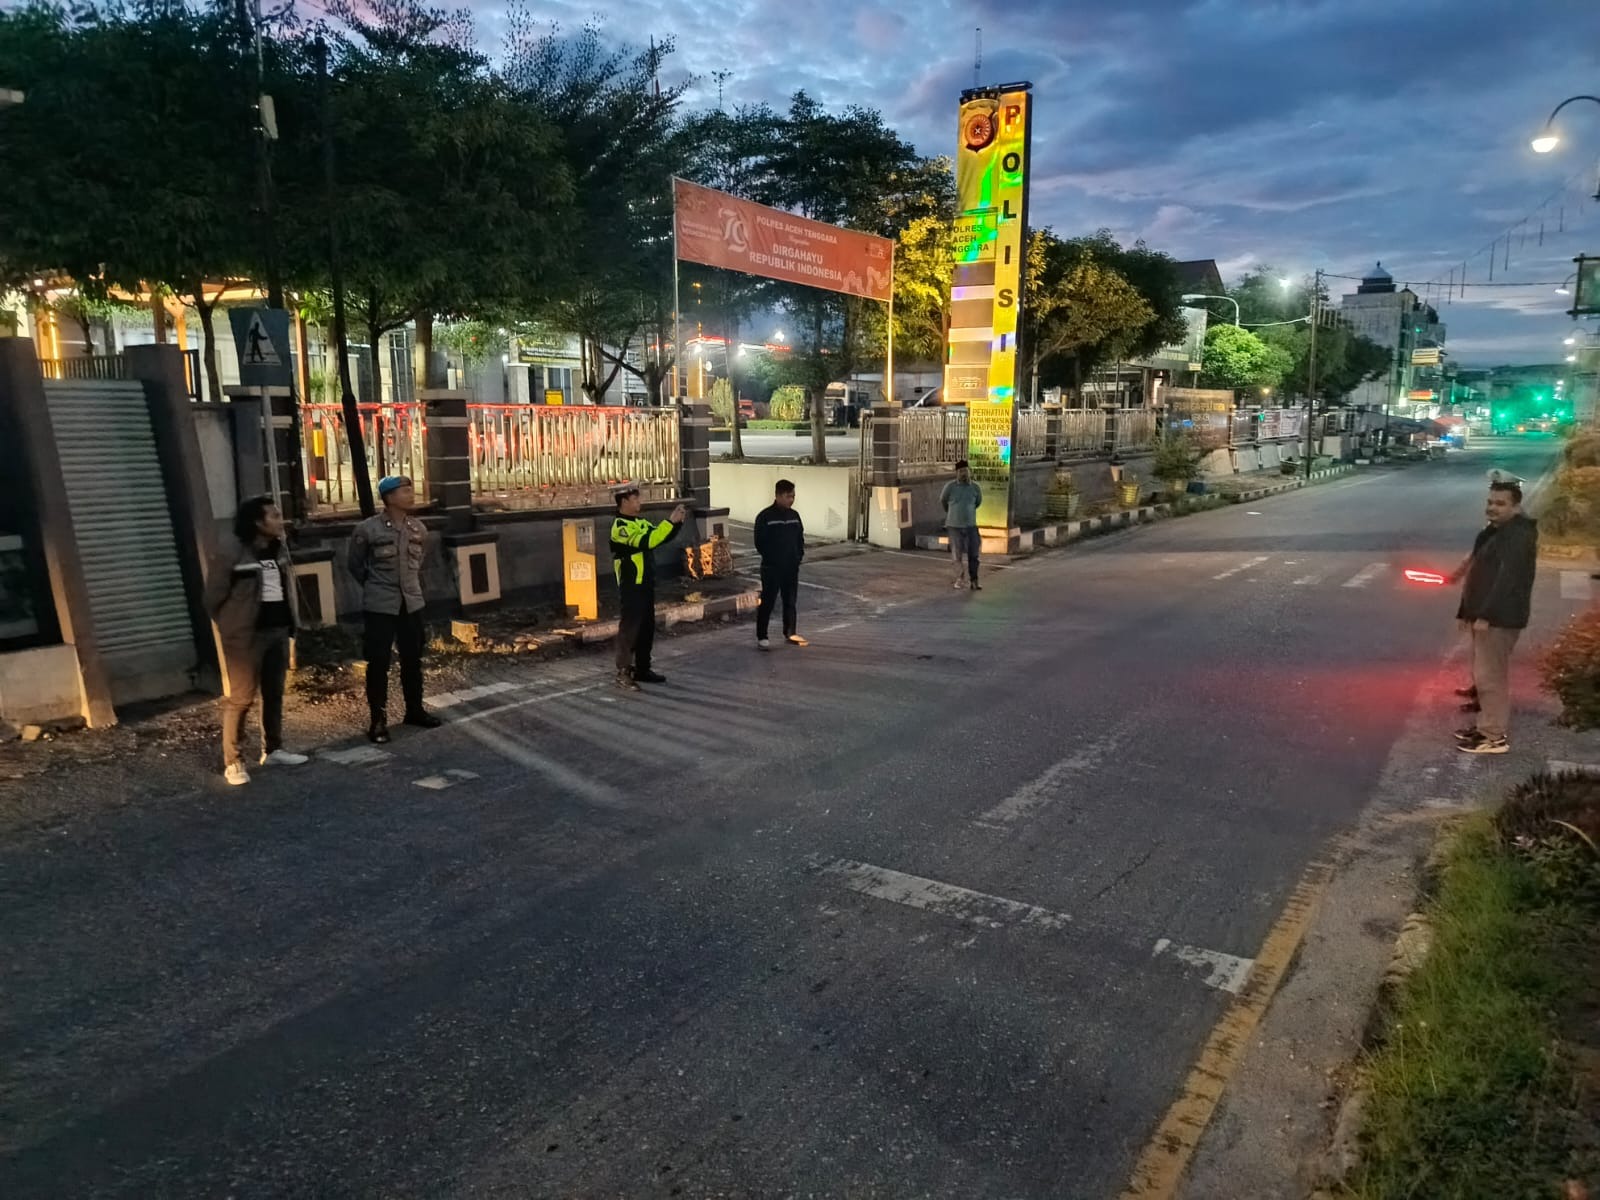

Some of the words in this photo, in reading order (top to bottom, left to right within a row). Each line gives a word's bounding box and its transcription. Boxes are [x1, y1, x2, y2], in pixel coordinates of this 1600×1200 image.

[756, 215, 784, 230] POLRES
[784, 223, 803, 235] ACEH
[803, 228, 838, 244] TENGGARA
[952, 235, 977, 243] ACEH
[772, 243, 824, 265] DIRGAHAYU
[749, 252, 796, 272] REPUBLIK
[797, 262, 842, 281] INDONESIA
[972, 408, 1010, 417] PERHATIAN
